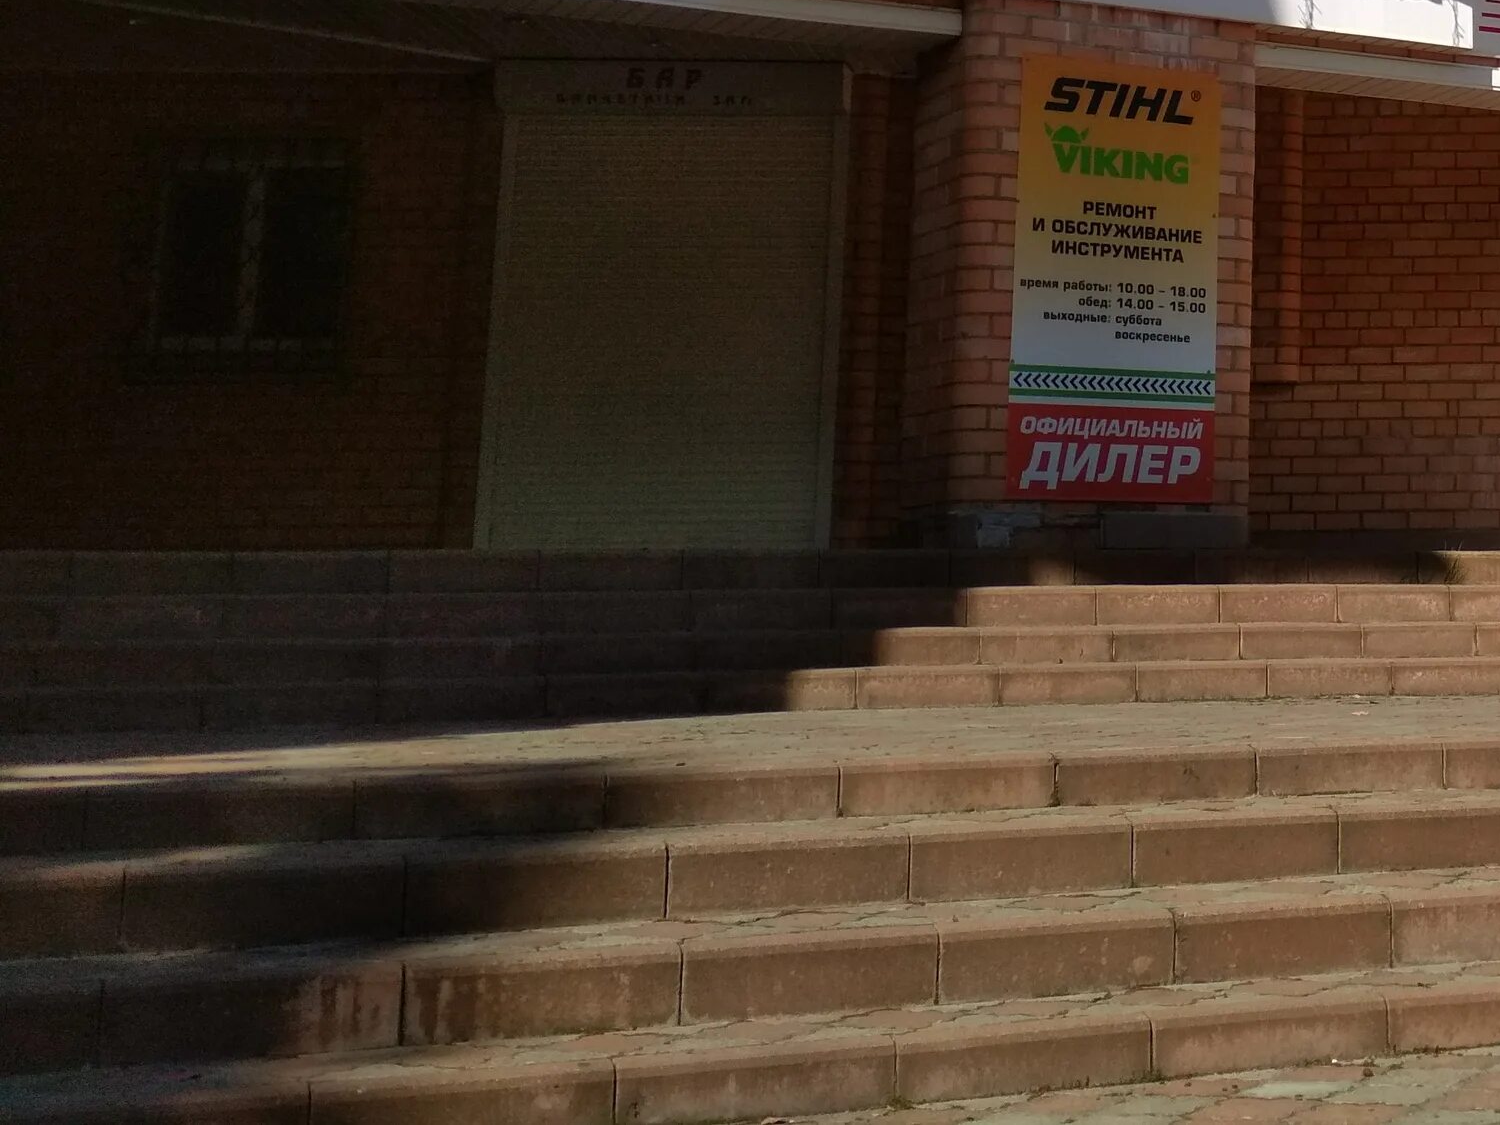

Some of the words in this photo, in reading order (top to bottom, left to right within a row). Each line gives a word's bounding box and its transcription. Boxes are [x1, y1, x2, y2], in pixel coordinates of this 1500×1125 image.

[626, 66, 704, 91] БАР
[1052, 142, 1190, 185] VIKING
[1083, 201, 1157, 220] РЕМОНТ
[1032, 217, 1045, 232] И
[1051, 218, 1203, 244] ОБСЛУЖИВАНИЕ
[1051, 240, 1184, 263] ИНСТРУМЕНТА
[1019, 278, 1059, 291] время
[1063, 281, 1112, 294] работы:
[1117, 282, 1154, 296] 10.00
[1170, 286, 1207, 299] 18.00
[1078, 297, 1112, 309] обед:
[1116, 298, 1154, 310] 14.00
[1169, 301, 1206, 314] 15.00
[1043, 311, 1111, 324] выходные:
[1115, 313, 1162, 327] суббота
[1114, 330, 1191, 343] воскресенье
[1020, 416, 1204, 440] ОФИЦИАЛЬНЫЙ
[1018, 441, 1201, 490] ДИЛЕР
